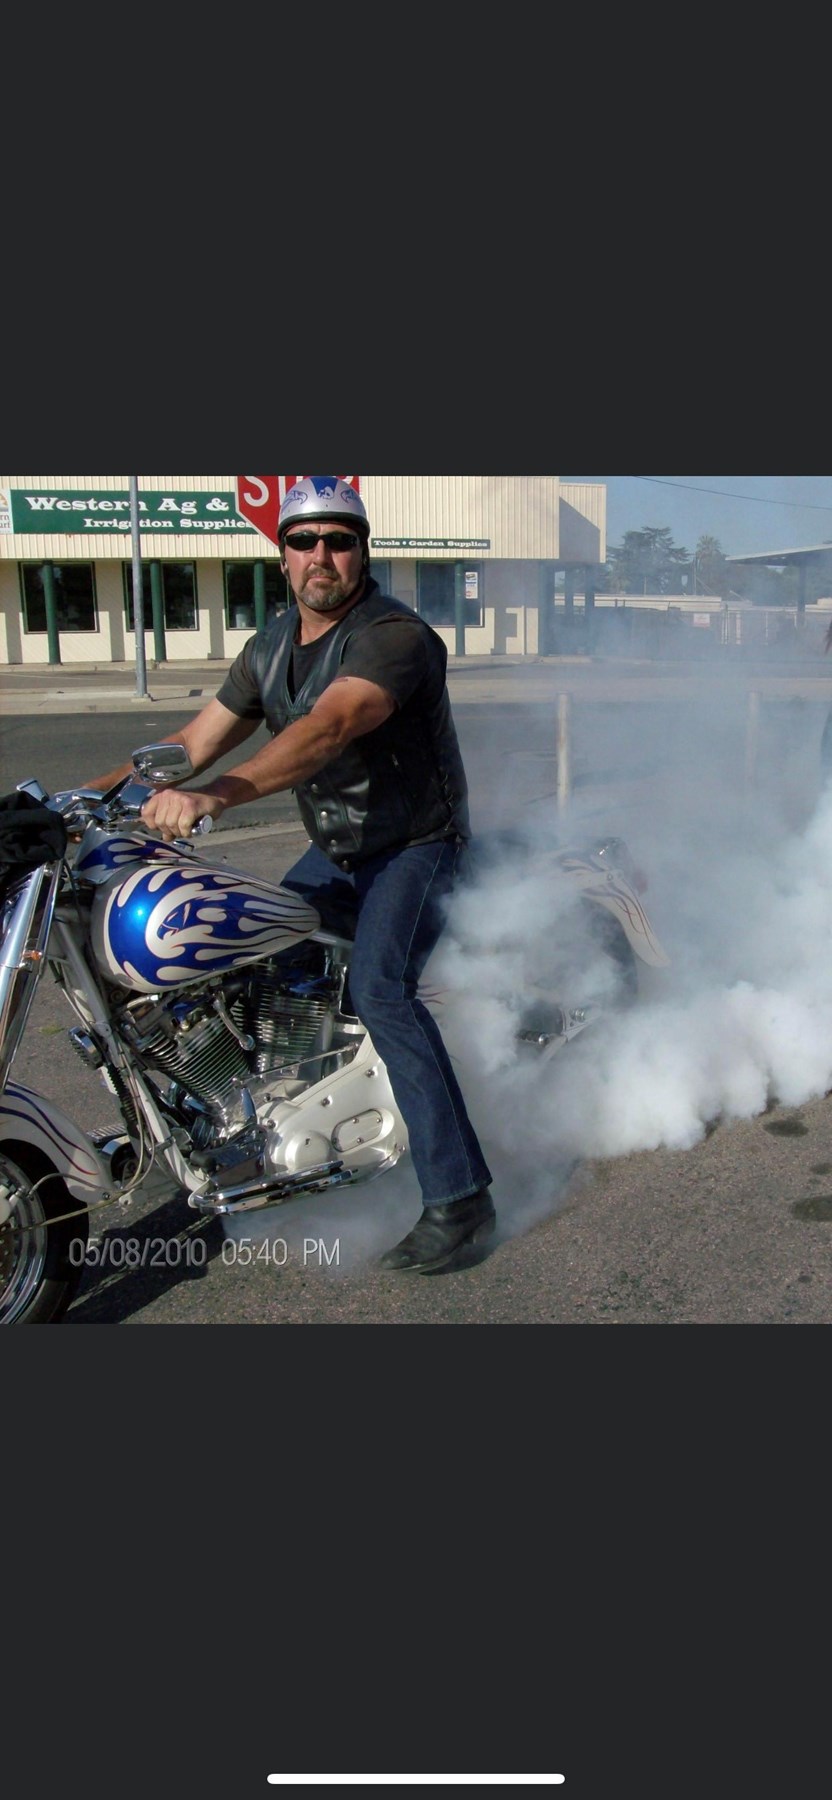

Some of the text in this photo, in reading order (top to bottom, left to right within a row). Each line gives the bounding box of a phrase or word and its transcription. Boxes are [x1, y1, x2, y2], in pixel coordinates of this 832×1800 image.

[157, 498, 197, 514] Ag
[206, 497, 229, 512] &
[447, 540, 488, 548] Supplies
